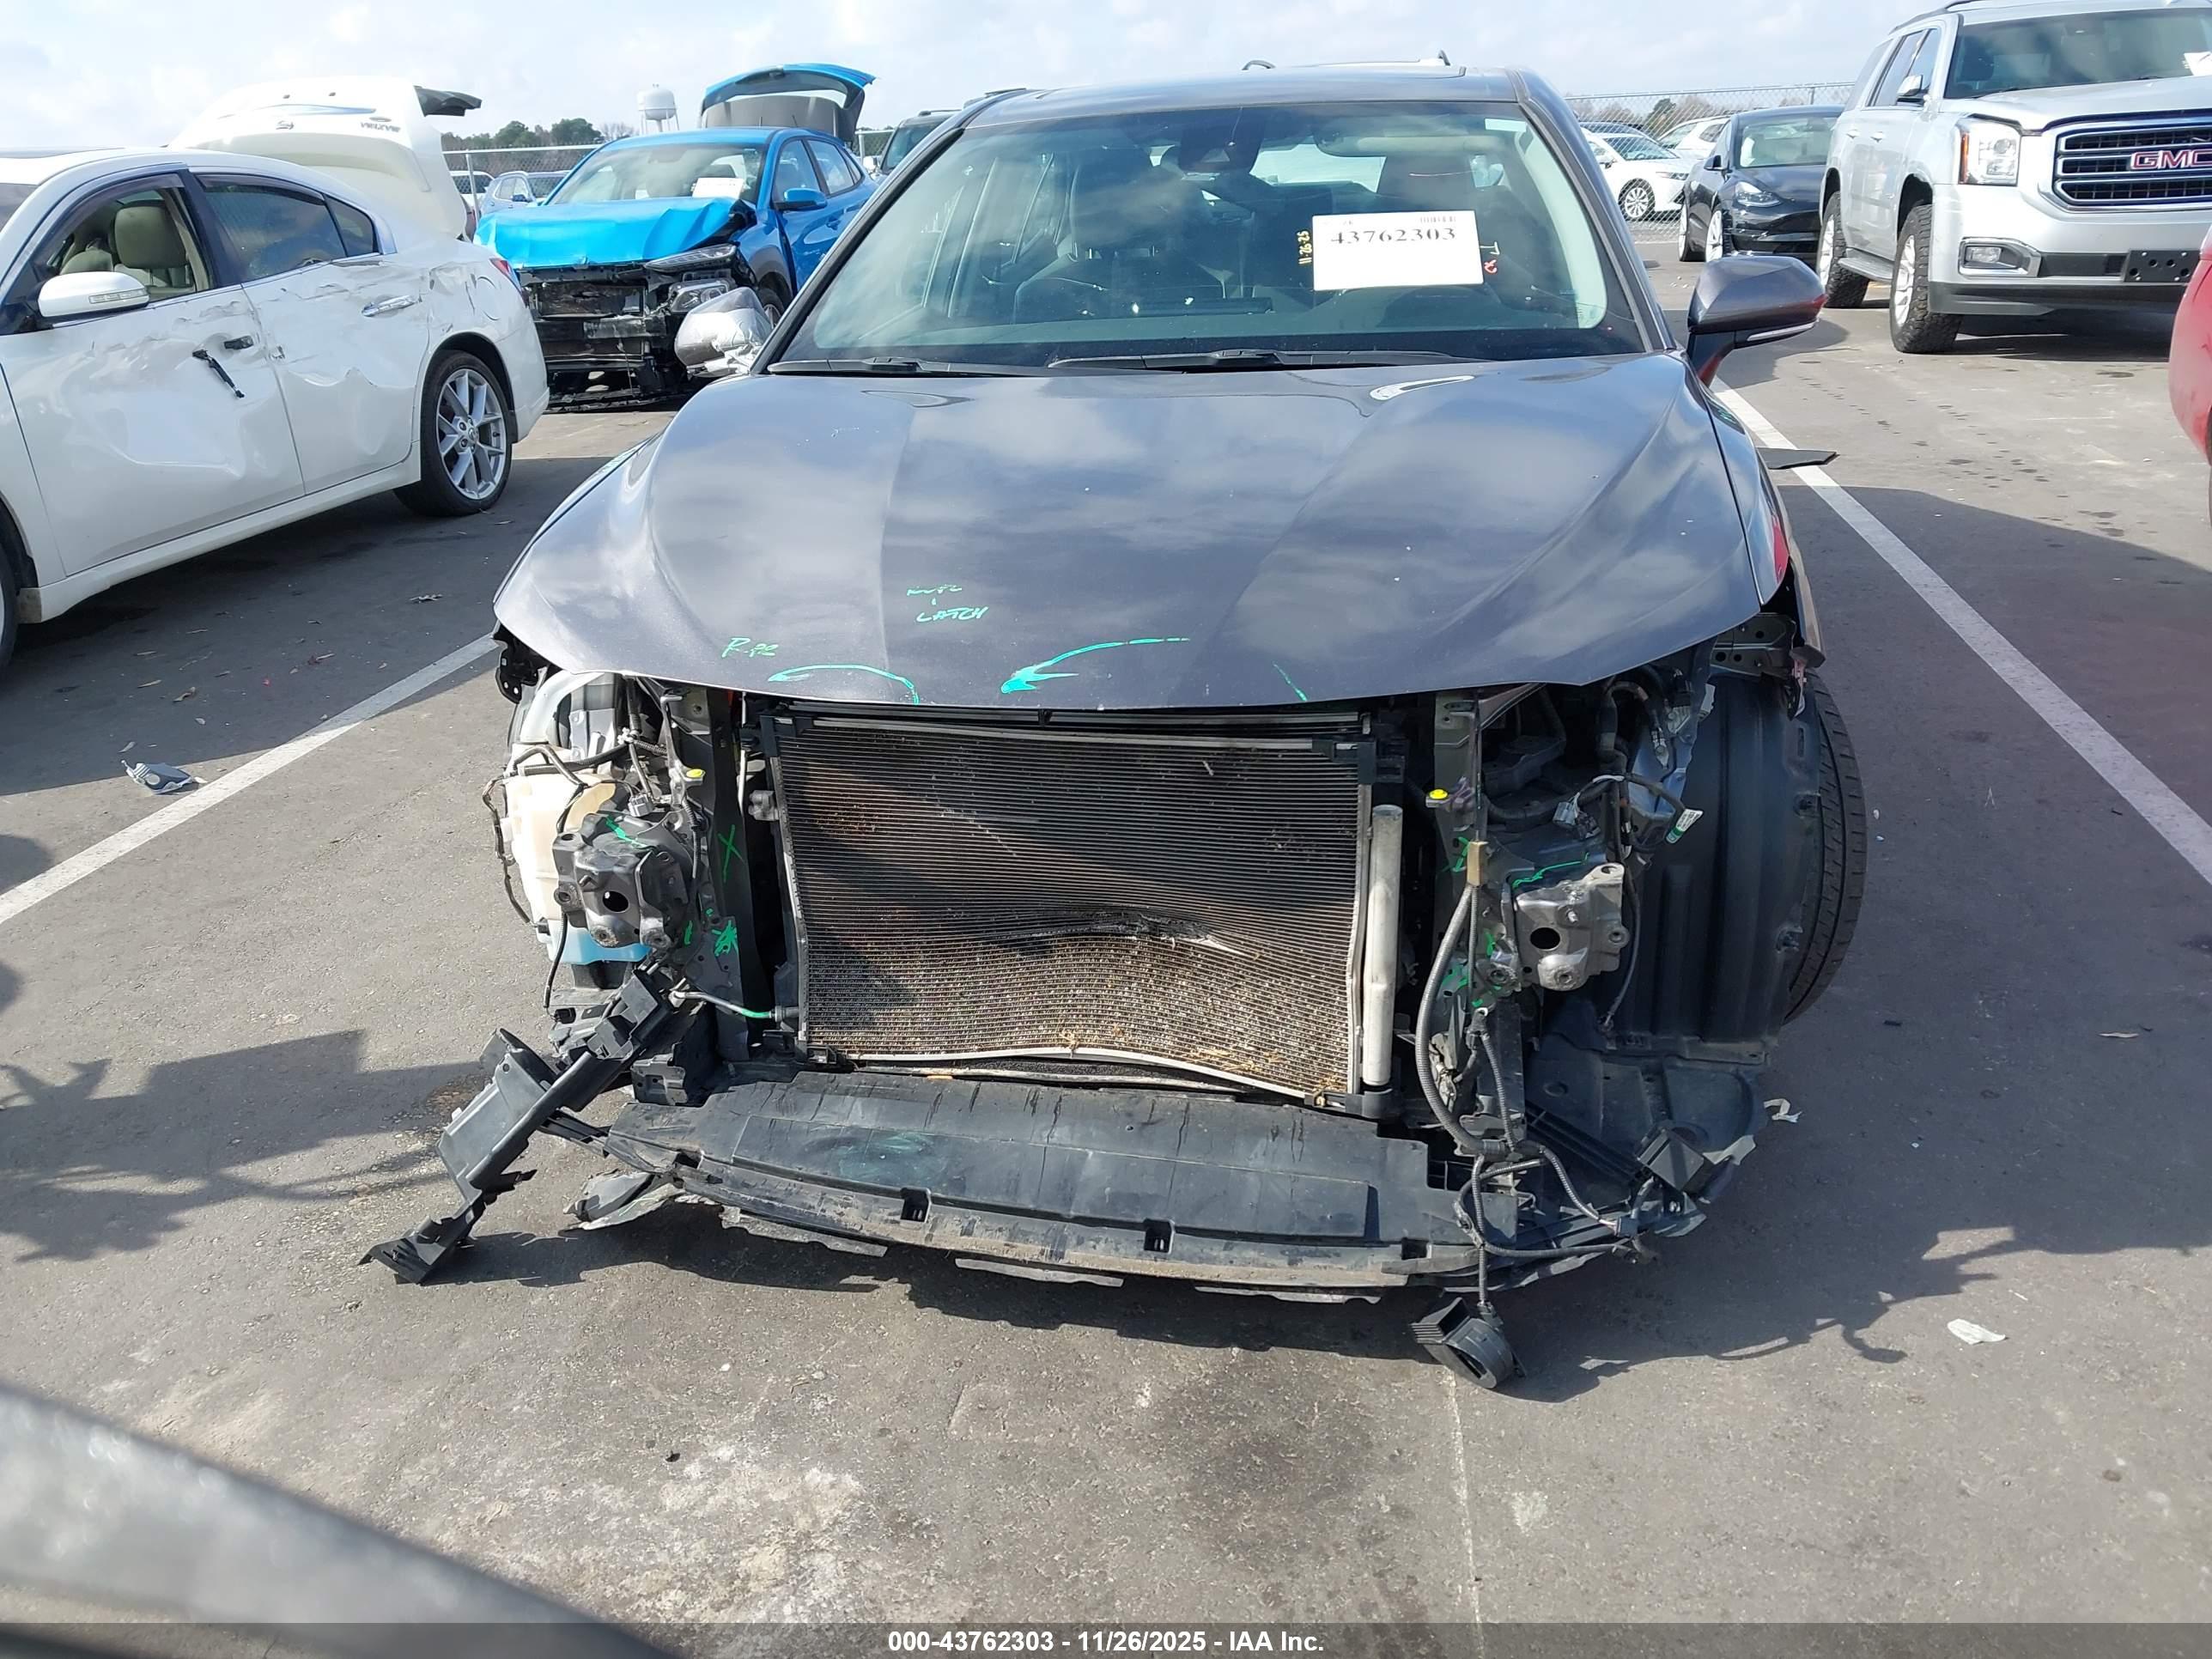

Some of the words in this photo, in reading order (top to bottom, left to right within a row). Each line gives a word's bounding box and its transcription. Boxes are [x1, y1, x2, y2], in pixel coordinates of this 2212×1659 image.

[2130, 149, 2212, 170] GMC
[1331, 228, 1456, 244] 43762303
[915, 605, 990, 623] LATCH
